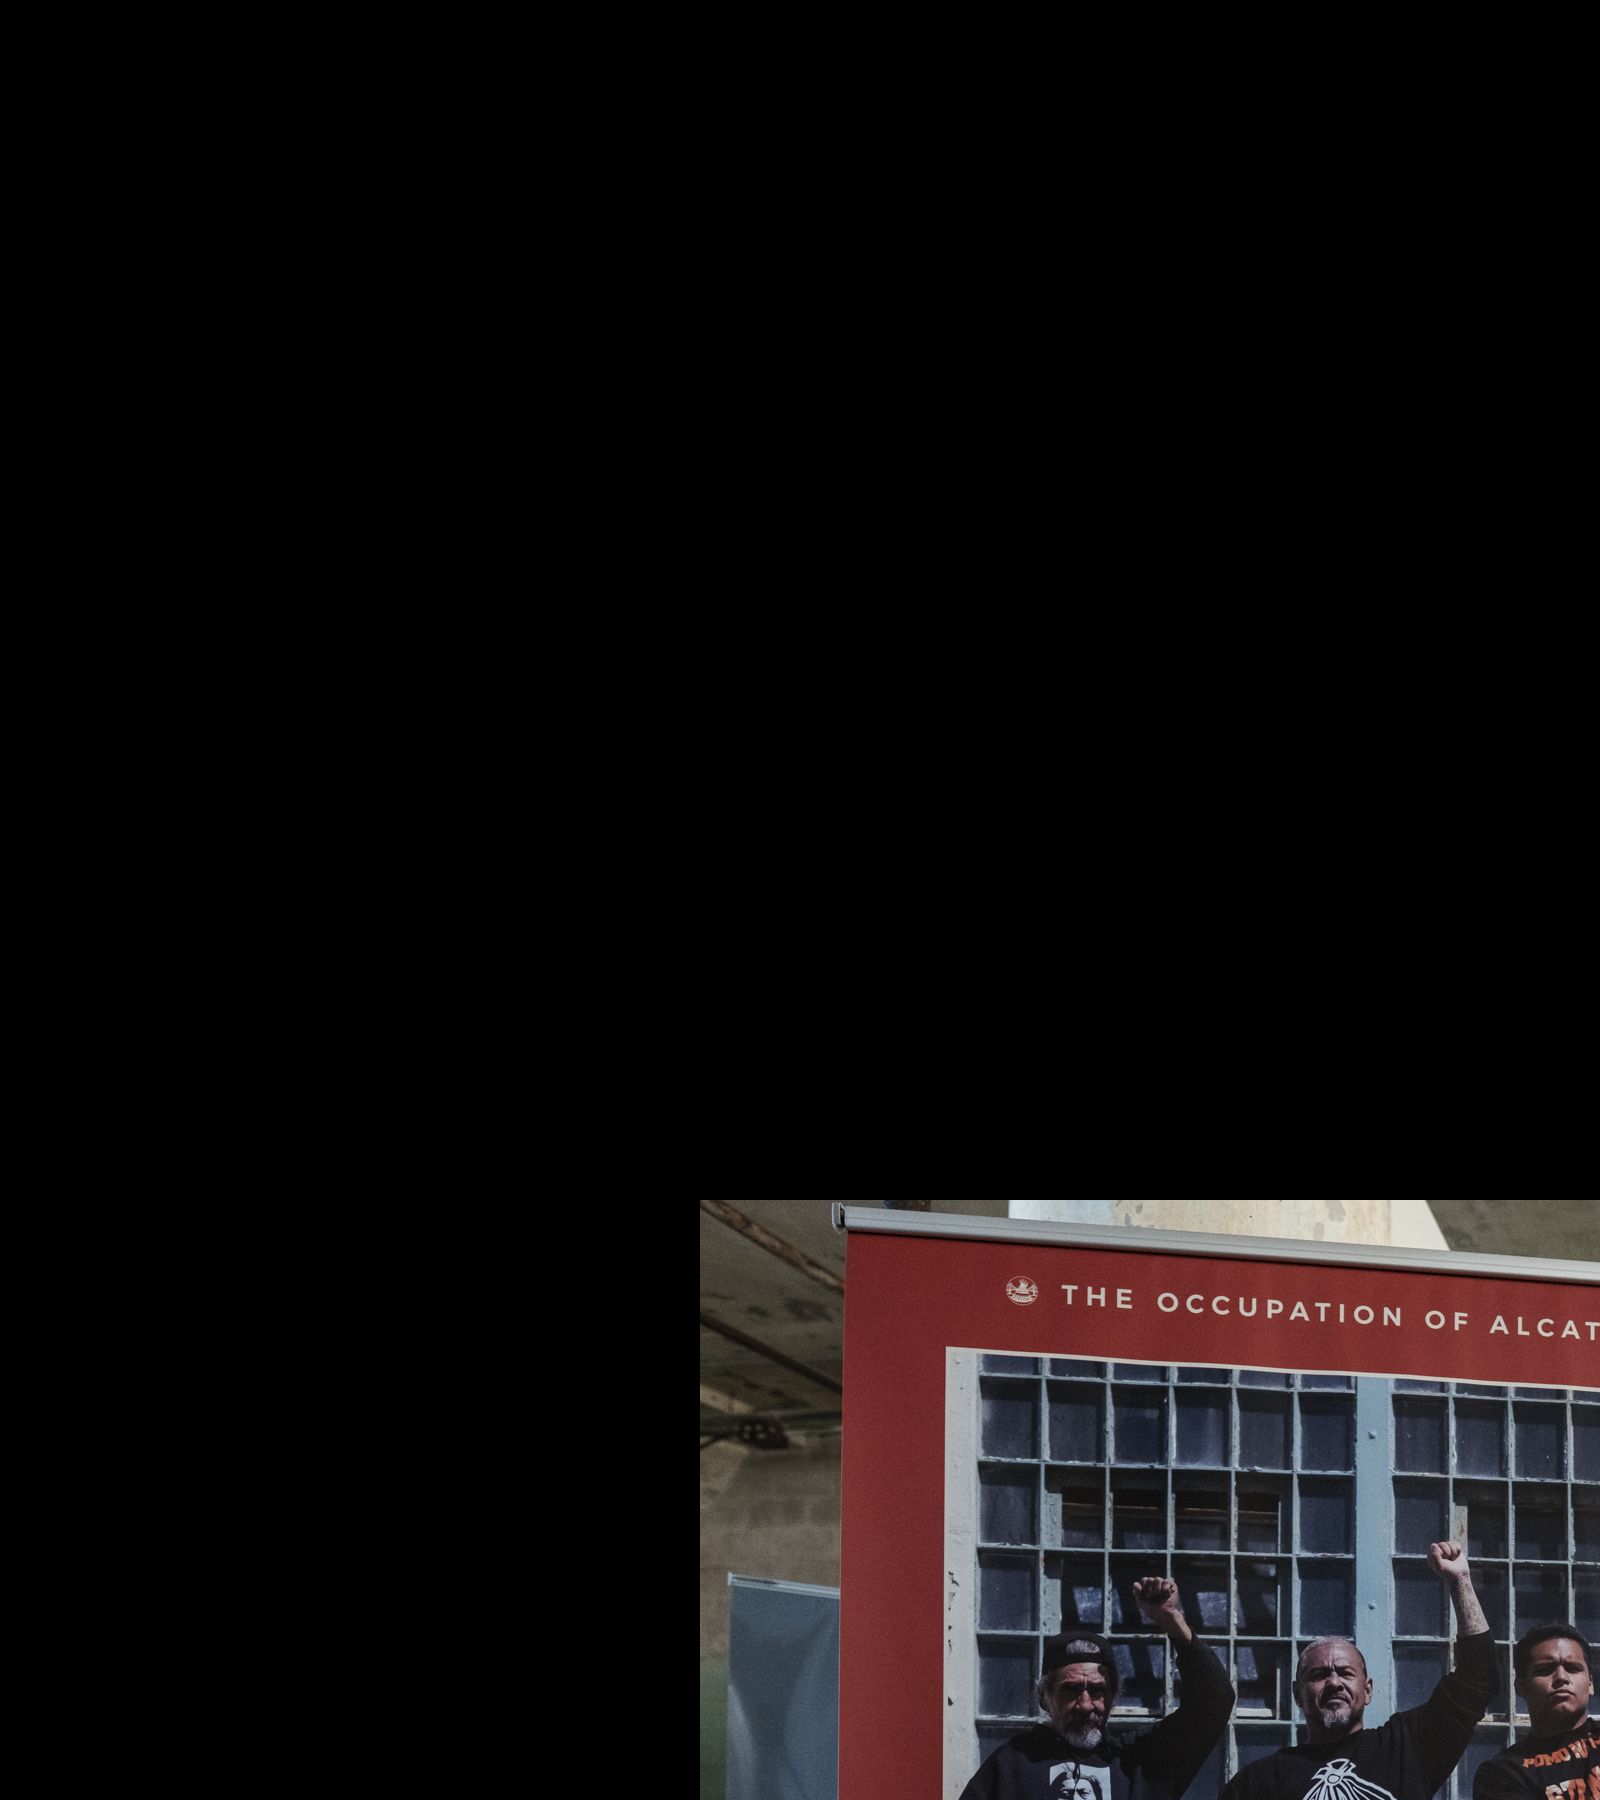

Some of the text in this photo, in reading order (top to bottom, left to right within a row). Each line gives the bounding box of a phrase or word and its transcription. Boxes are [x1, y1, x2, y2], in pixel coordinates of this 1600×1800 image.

[1061, 1284, 1133, 1310] THE
[1157, 1292, 1402, 1327] OCCUPATION
[1424, 1310, 1469, 1333] OF
